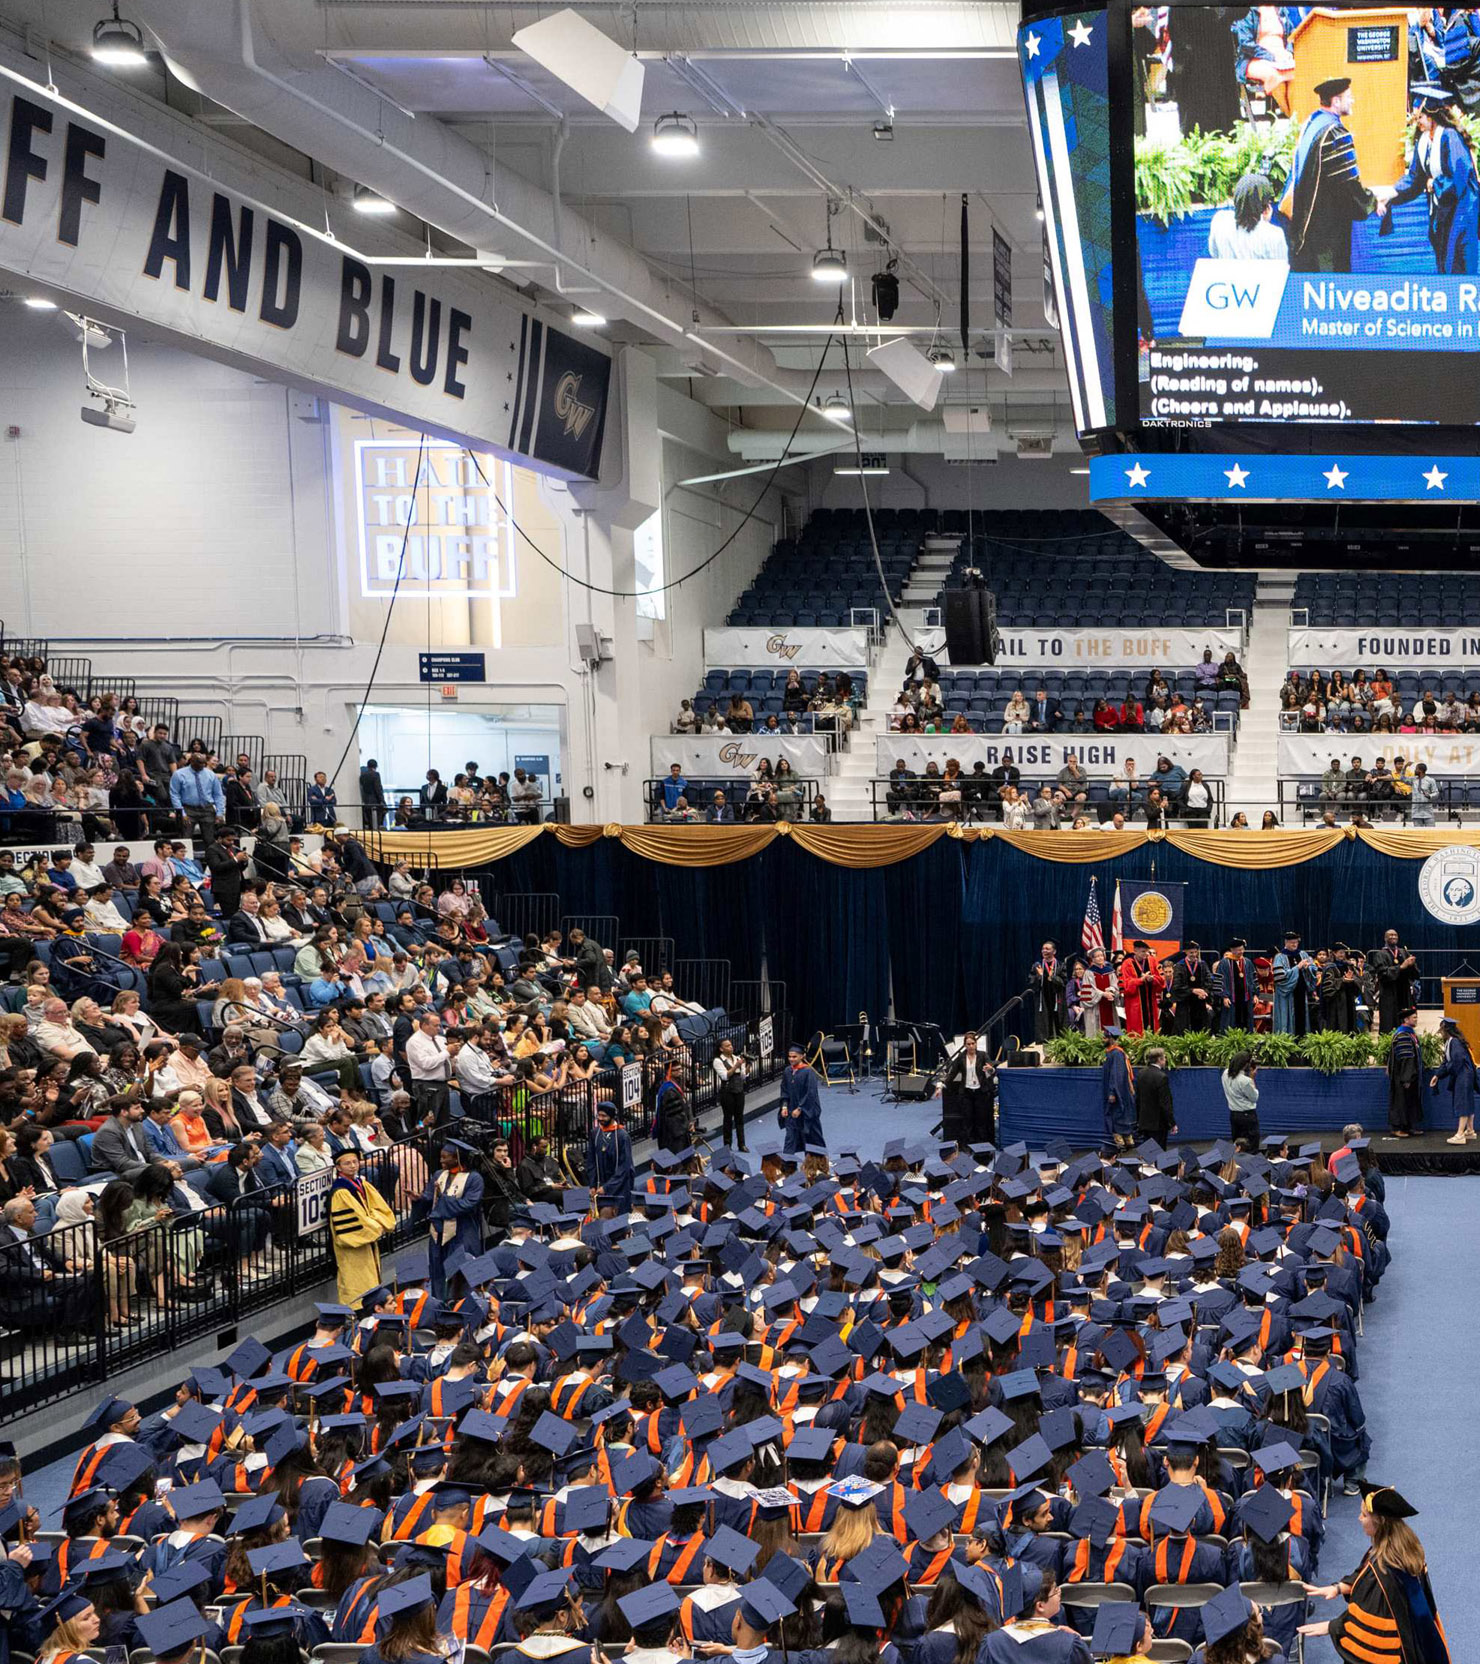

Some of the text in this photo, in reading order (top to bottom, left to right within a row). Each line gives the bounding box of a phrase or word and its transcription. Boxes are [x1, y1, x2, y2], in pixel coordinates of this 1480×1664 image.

[142, 169, 303, 330] AND
[335, 254, 472, 400] BLUE
[1205, 282, 1261, 311] GW
[1303, 281, 1448, 311] Niveadita
[1302, 318, 1360, 336] Master
[1364, 317, 1383, 336] of
[1387, 319, 1452, 338] Science
[1458, 320, 1473, 338] in
[1150, 353, 1258, 371] Engineering.
[1151, 377, 1323, 396] (Reading of names).
[1151, 398, 1351, 418] (Cheers and Applause).
[1142, 420, 1212, 428] DAKTRONICS
[373, 495, 418, 526] TO
[376, 535, 498, 579] BUFF
[766, 635, 803, 659] GW
[997, 638, 1171, 656] AIL TO THE BUFF
[1358, 637, 1451, 655] FOUNDED
[718, 742, 757, 769] GW
[987, 745, 1116, 764] RAISE HIGH
[1382, 745, 1436, 764] ONLY
[1447, 745, 1475, 764] AT
[624, 1077, 640, 1102] 104
[300, 1173, 332, 1196] SECTION
